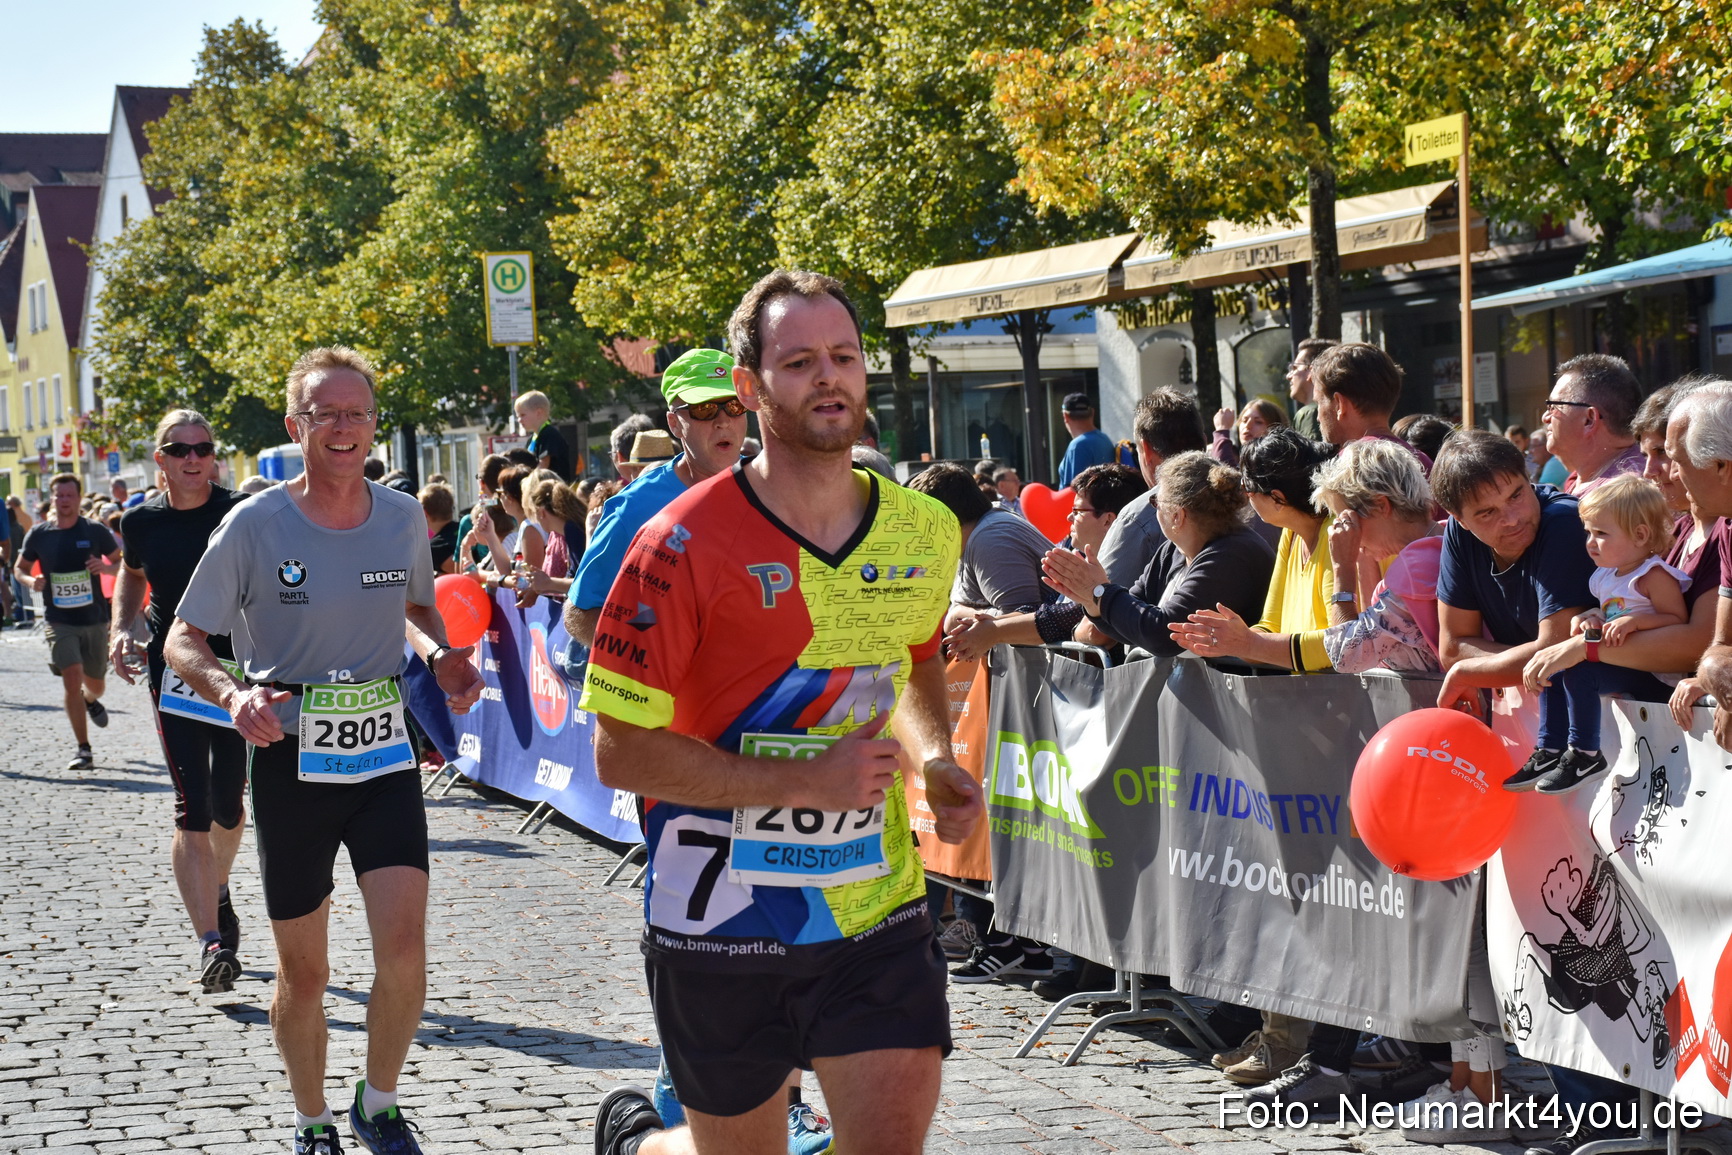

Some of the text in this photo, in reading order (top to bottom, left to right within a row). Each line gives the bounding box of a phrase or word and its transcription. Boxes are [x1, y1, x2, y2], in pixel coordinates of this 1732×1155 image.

[1416, 131, 1459, 152] Toiletten
[501, 267, 517, 286] H
[635, 540, 679, 568] dienwerk
[361, 570, 406, 584] BOCK
[56, 584, 87, 596] 2594
[883, 586, 914, 594] NEUMARKT
[603, 610, 622, 622] EARS
[616, 605, 633, 617] NEXT
[595, 633, 649, 669] MW M.
[311, 680, 395, 710] BOCK
[482, 688, 502, 701] MOBILE
[314, 712, 392, 749] 2803
[324, 756, 383, 774] Stefan
[1407, 739, 1489, 788] RÖDL
[1451, 769, 1486, 794] energie
[1189, 773, 1341, 834] INDUSTRY
[735, 806, 743, 834] ZEITGE
[988, 810, 1045, 842] inspired
[764, 843, 865, 868] CRISTOPH
[677, 829, 731, 921] 7
[655, 933, 786, 956] www.bmw-partl.de
